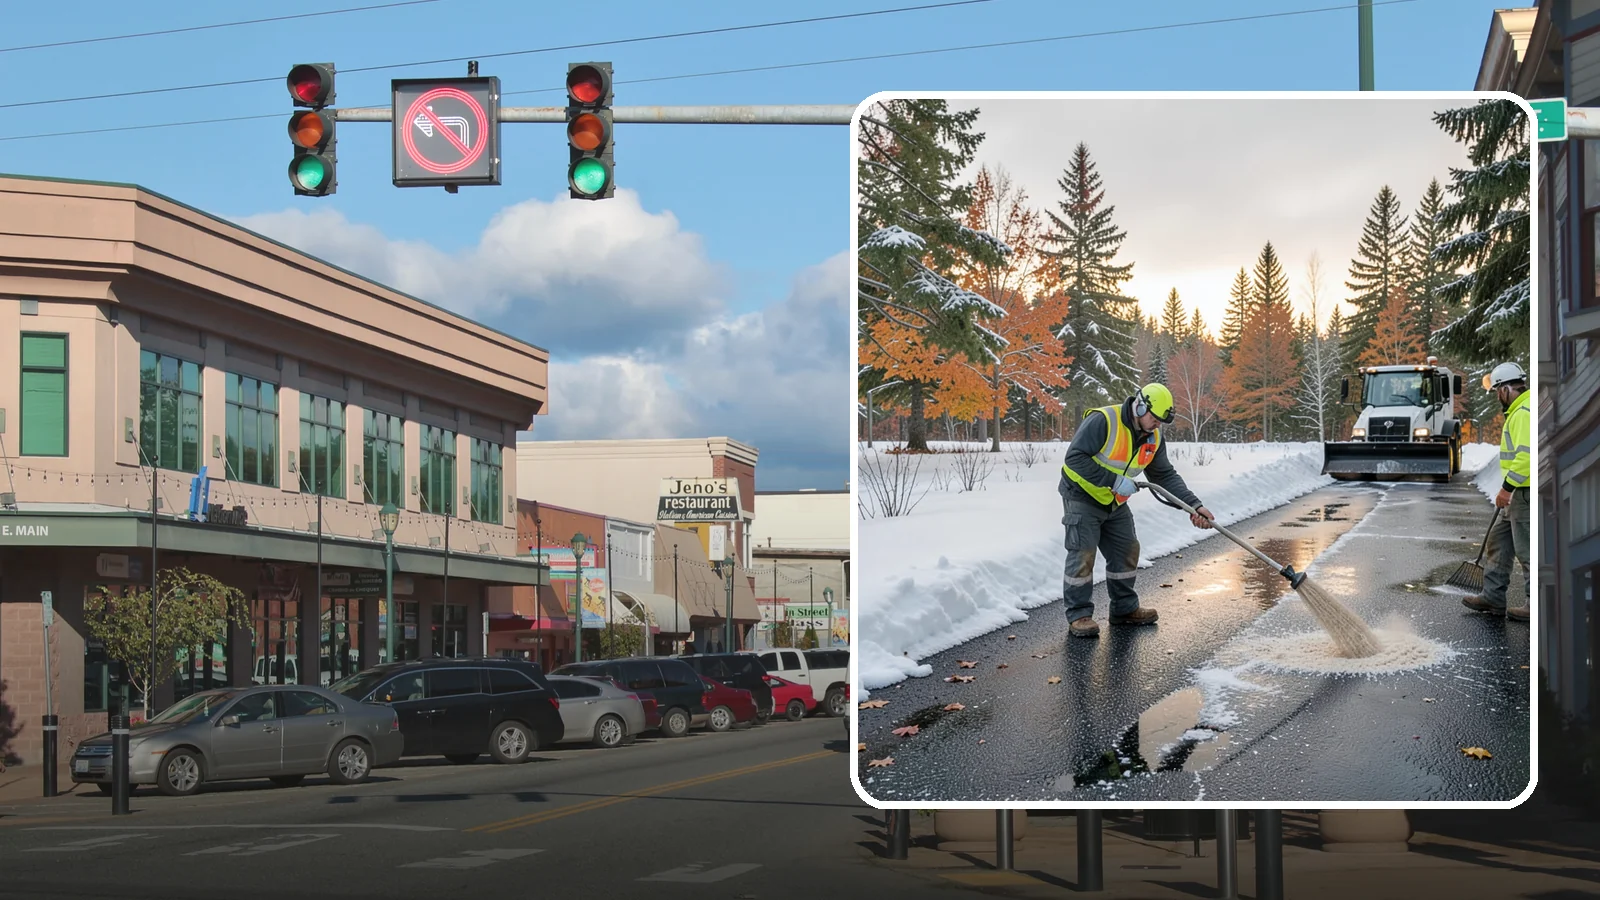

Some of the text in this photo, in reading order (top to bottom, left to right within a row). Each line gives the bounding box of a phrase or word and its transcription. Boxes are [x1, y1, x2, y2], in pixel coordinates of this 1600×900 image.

[669, 479, 727, 494] Jeno's
[665, 496, 731, 509] restaurant
[658, 510, 682, 519] Italian
[686, 509, 714, 519] American
[715, 509, 737, 519] Cuisine
[2, 525, 49, 536] E. MAIN
[786, 608, 795, 617] in
[797, 607, 828, 617] Street
[790, 619, 824, 627] lass
